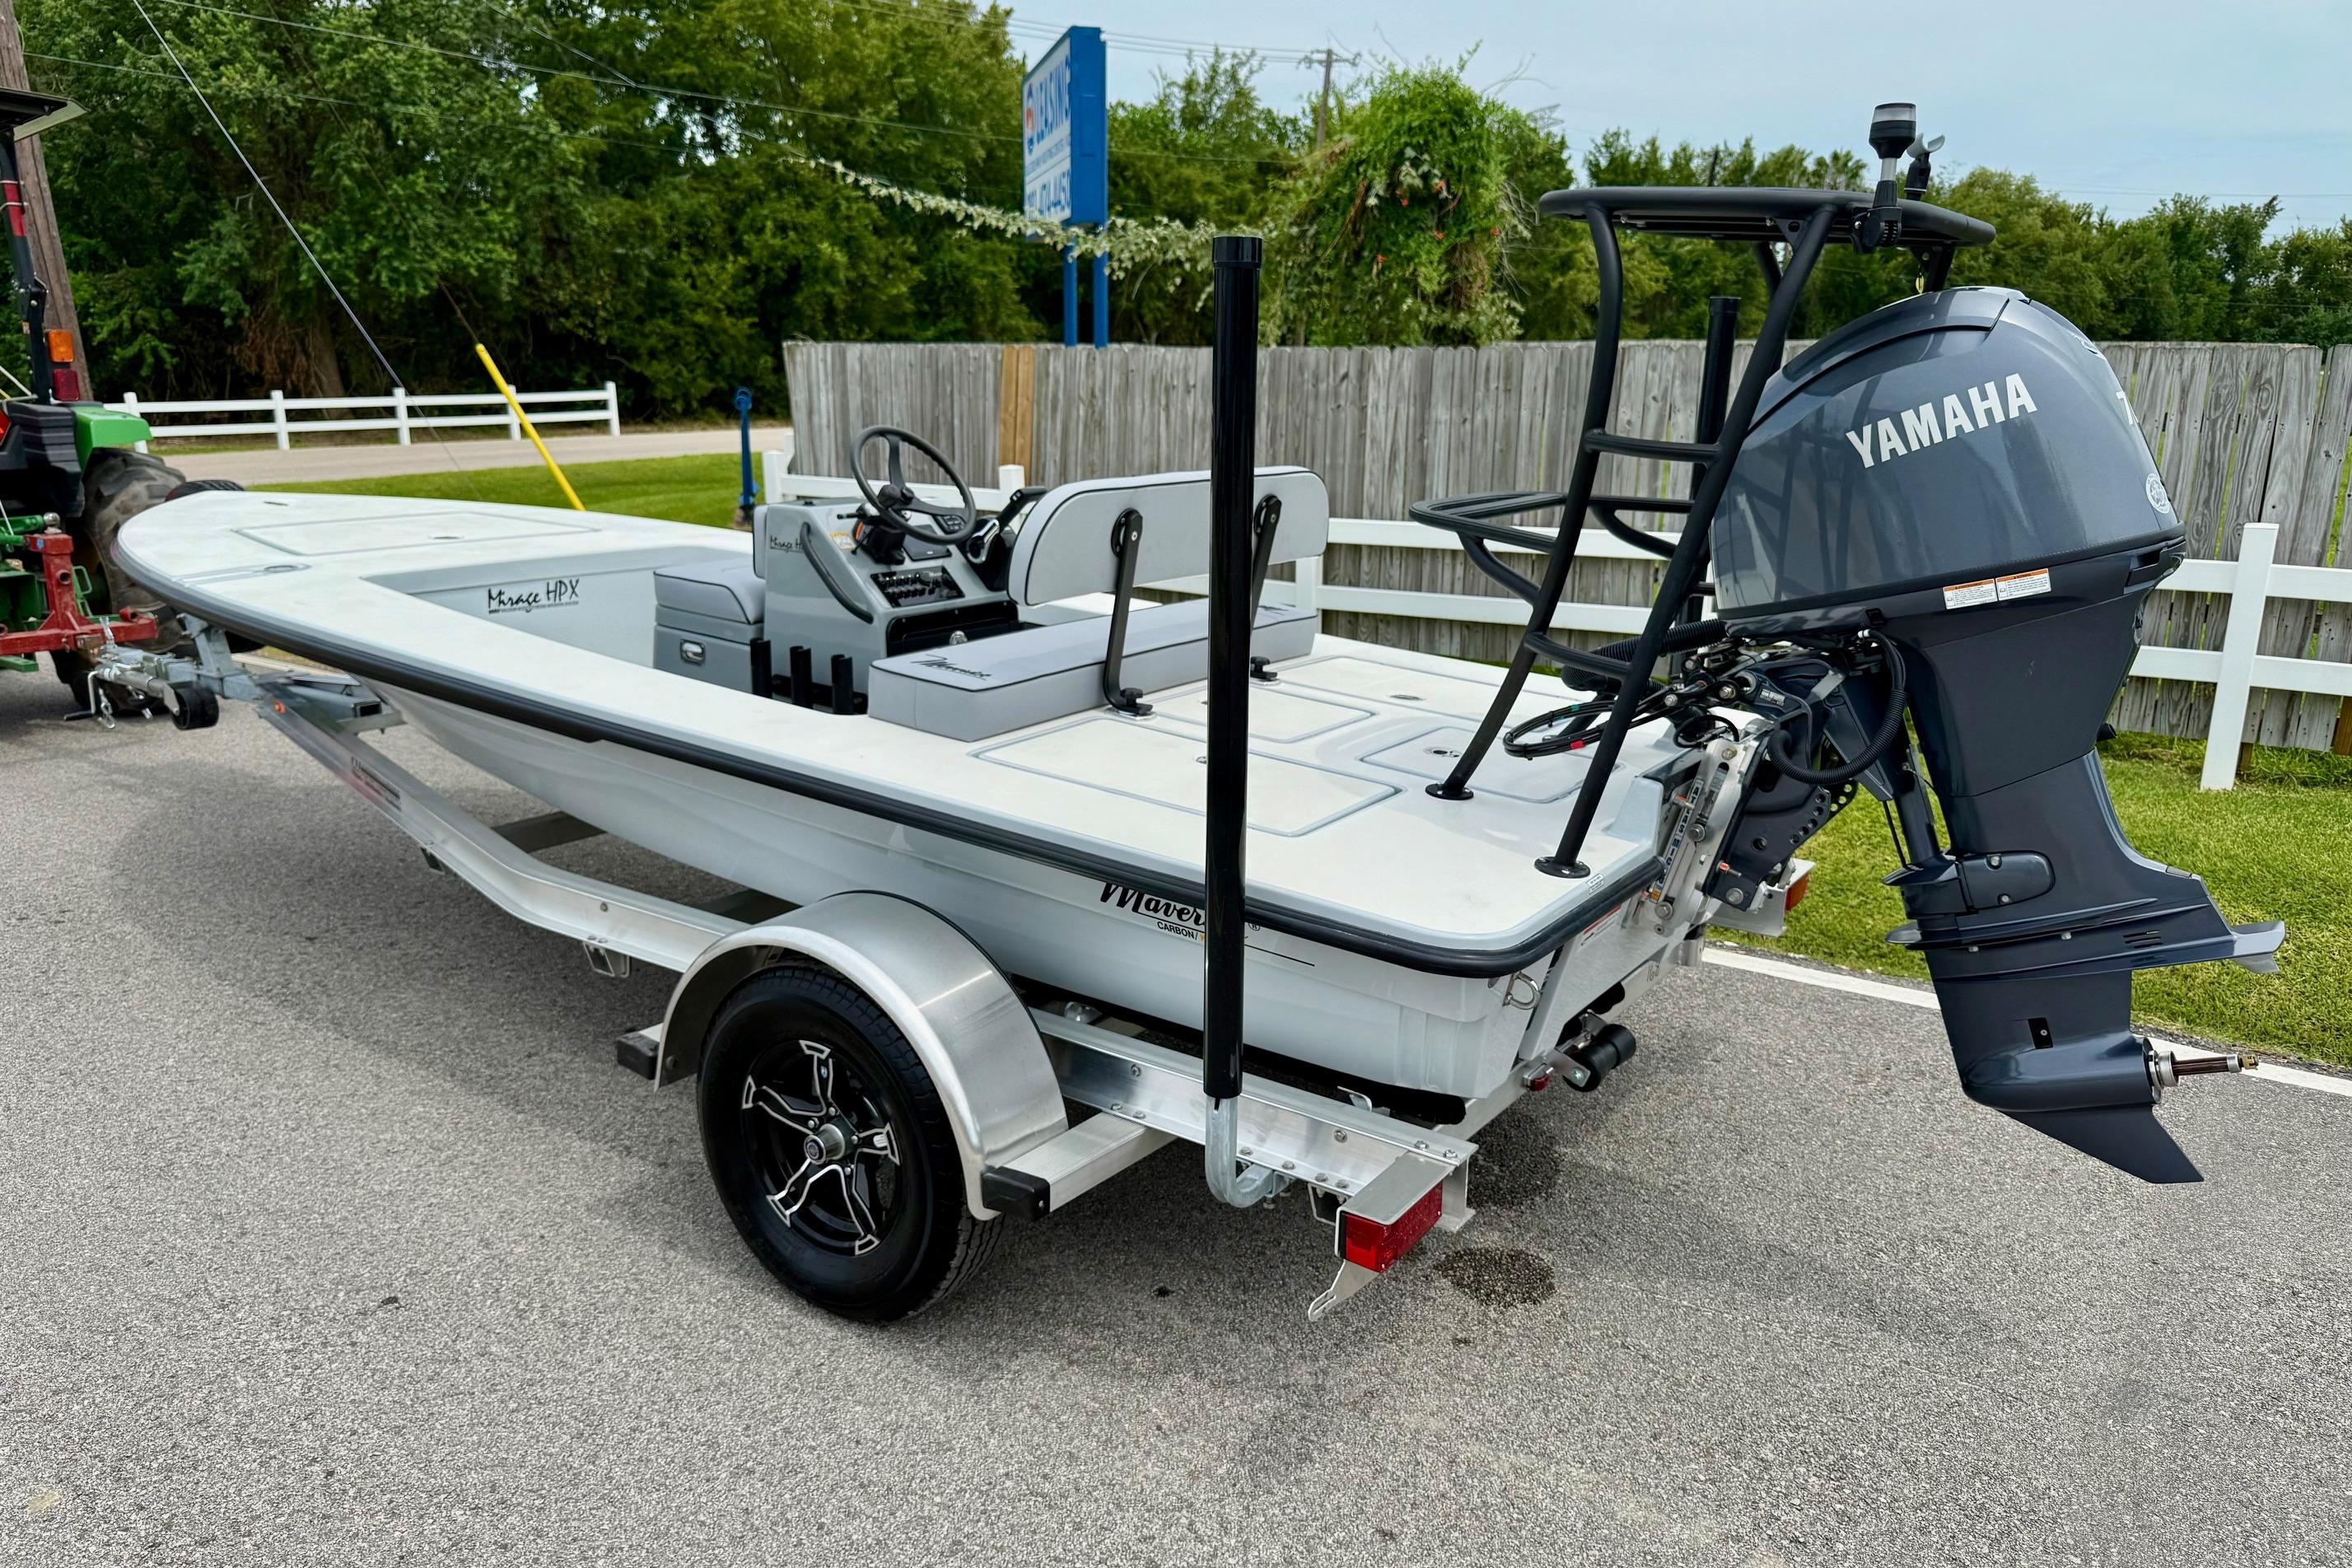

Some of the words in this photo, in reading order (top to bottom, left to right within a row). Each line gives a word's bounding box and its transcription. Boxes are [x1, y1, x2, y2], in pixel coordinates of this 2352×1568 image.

[1846, 373, 2037, 468] YAMAHA
[488, 588, 542, 613] Mirage
[546, 578, 580, 602] HPX
